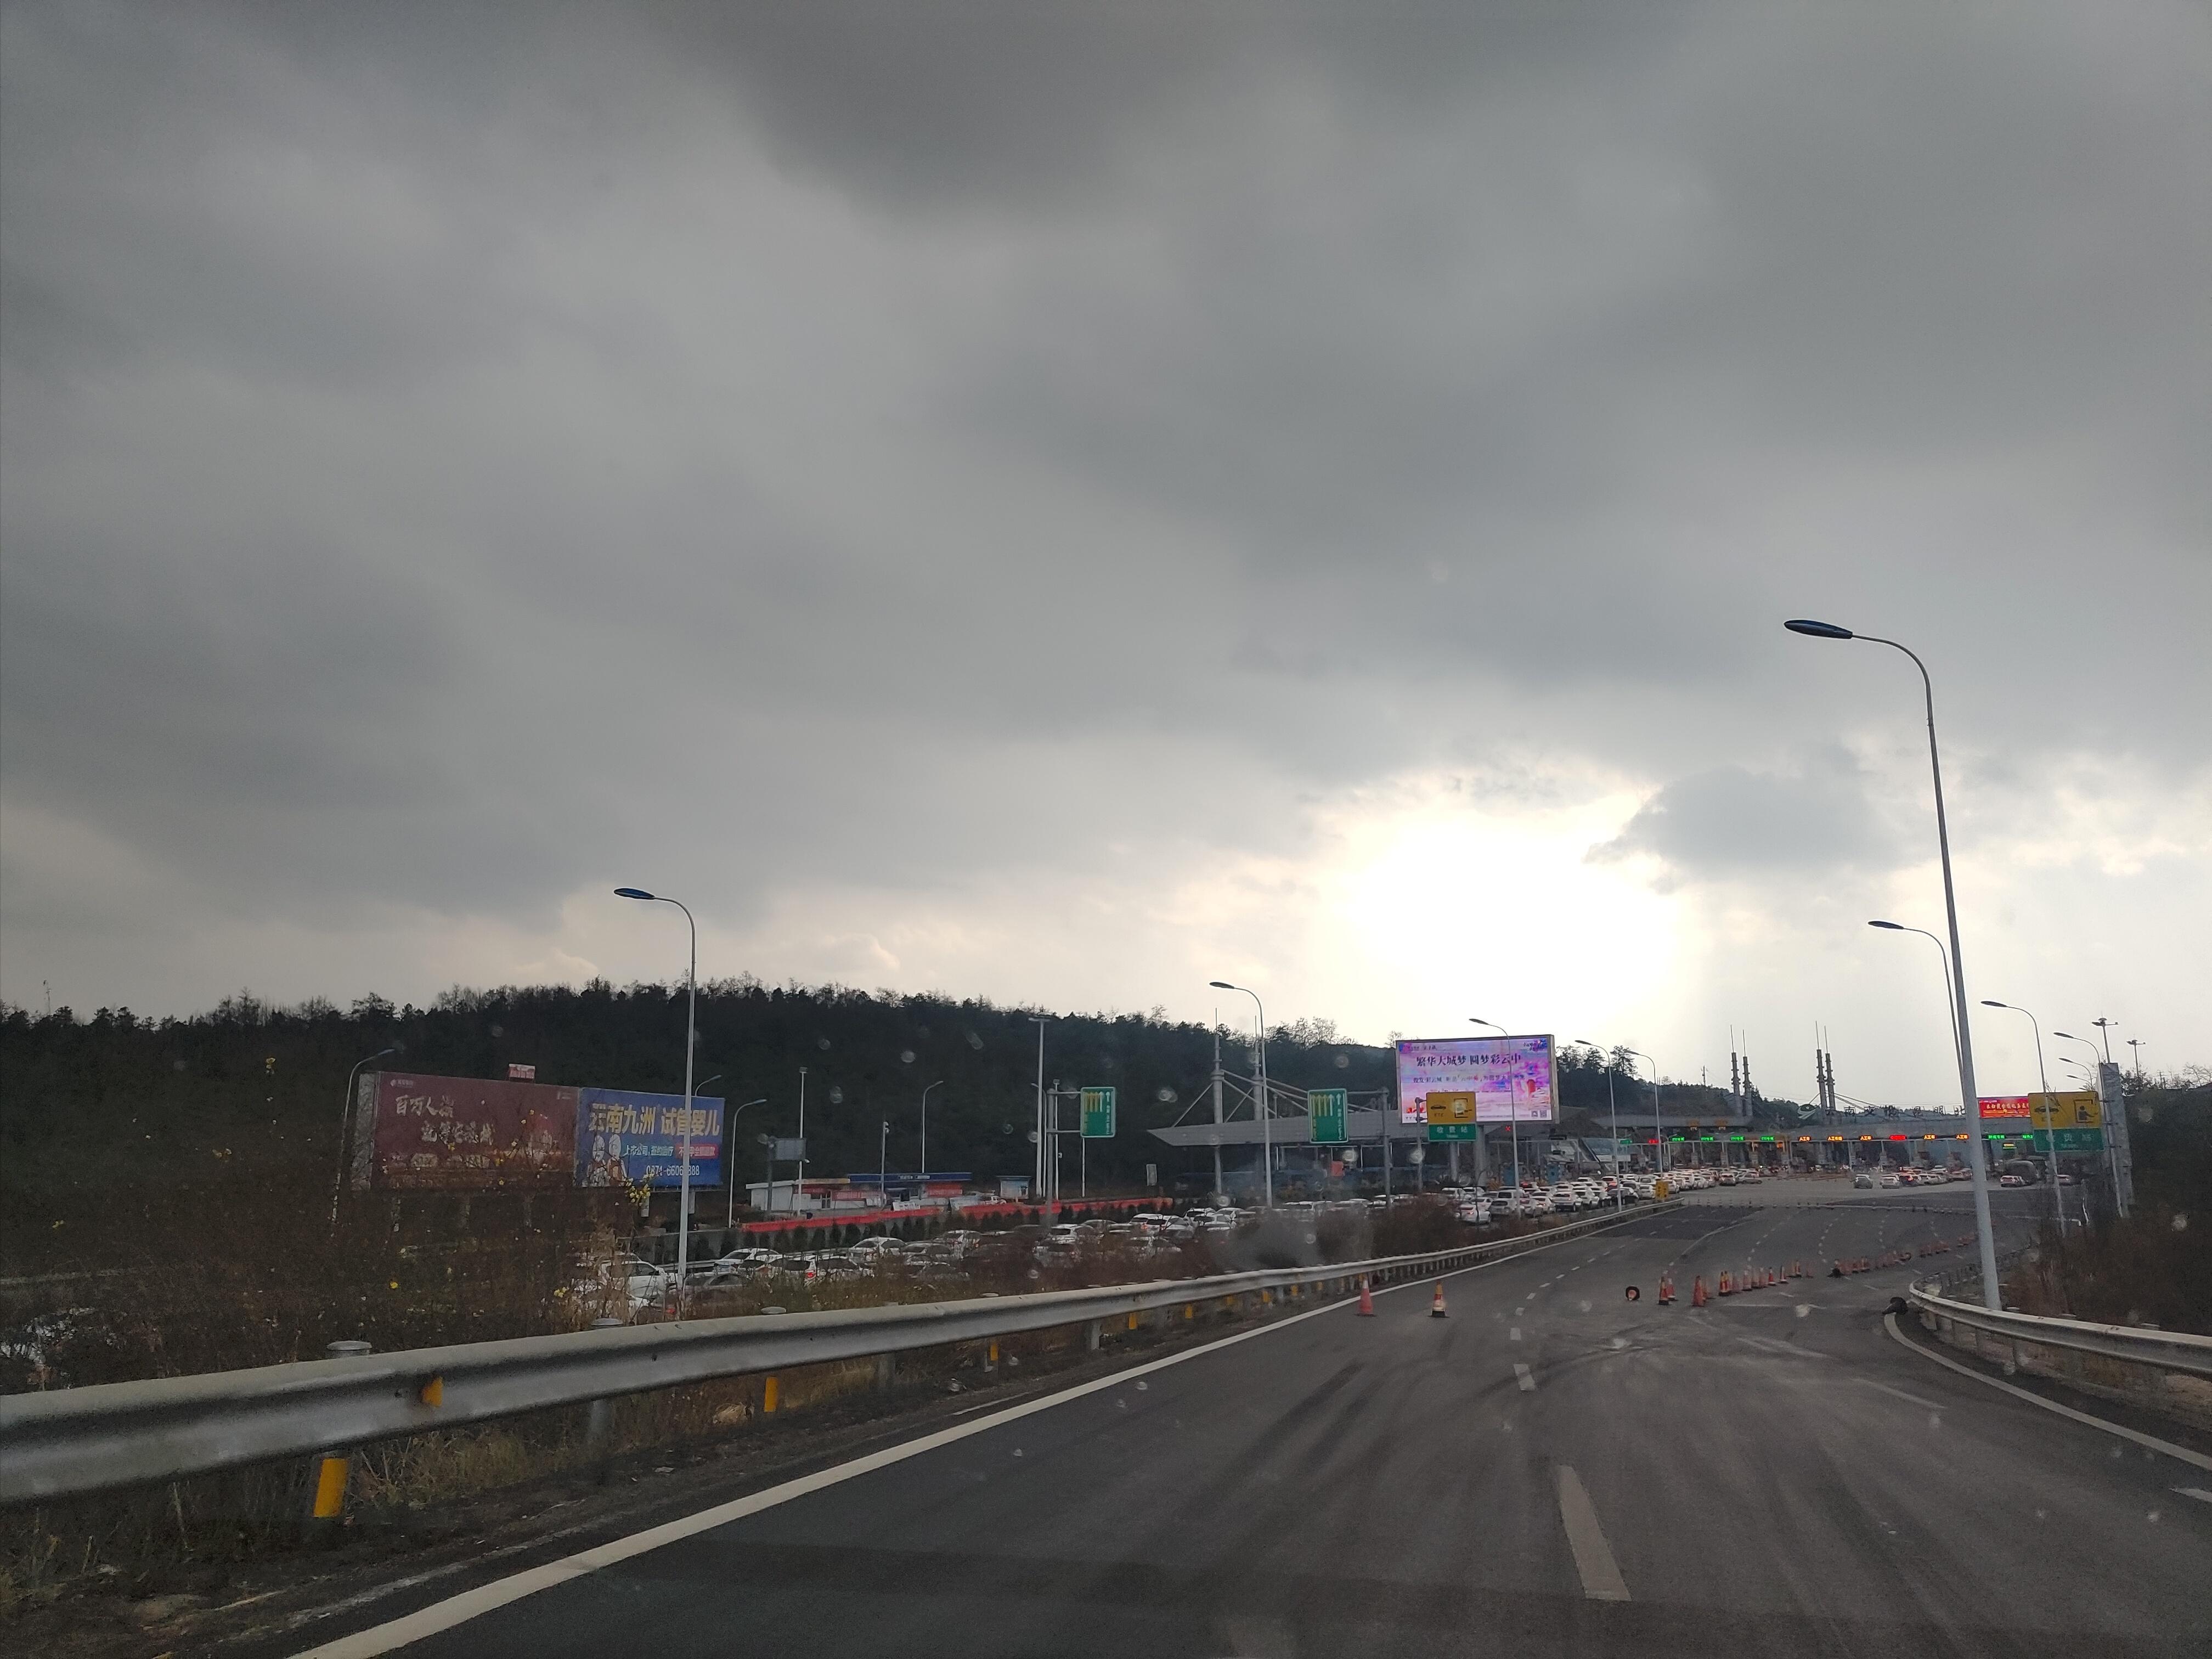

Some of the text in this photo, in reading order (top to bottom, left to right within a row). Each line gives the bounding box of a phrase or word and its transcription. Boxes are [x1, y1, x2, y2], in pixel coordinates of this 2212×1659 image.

[1417, 1053, 1521, 1067] 繁华大城梦 圆梦彩云中
[589, 1103, 720, 1136] 云南九洲 试管婴儿
[646, 1164, 700, 1176] 0871-6606888
